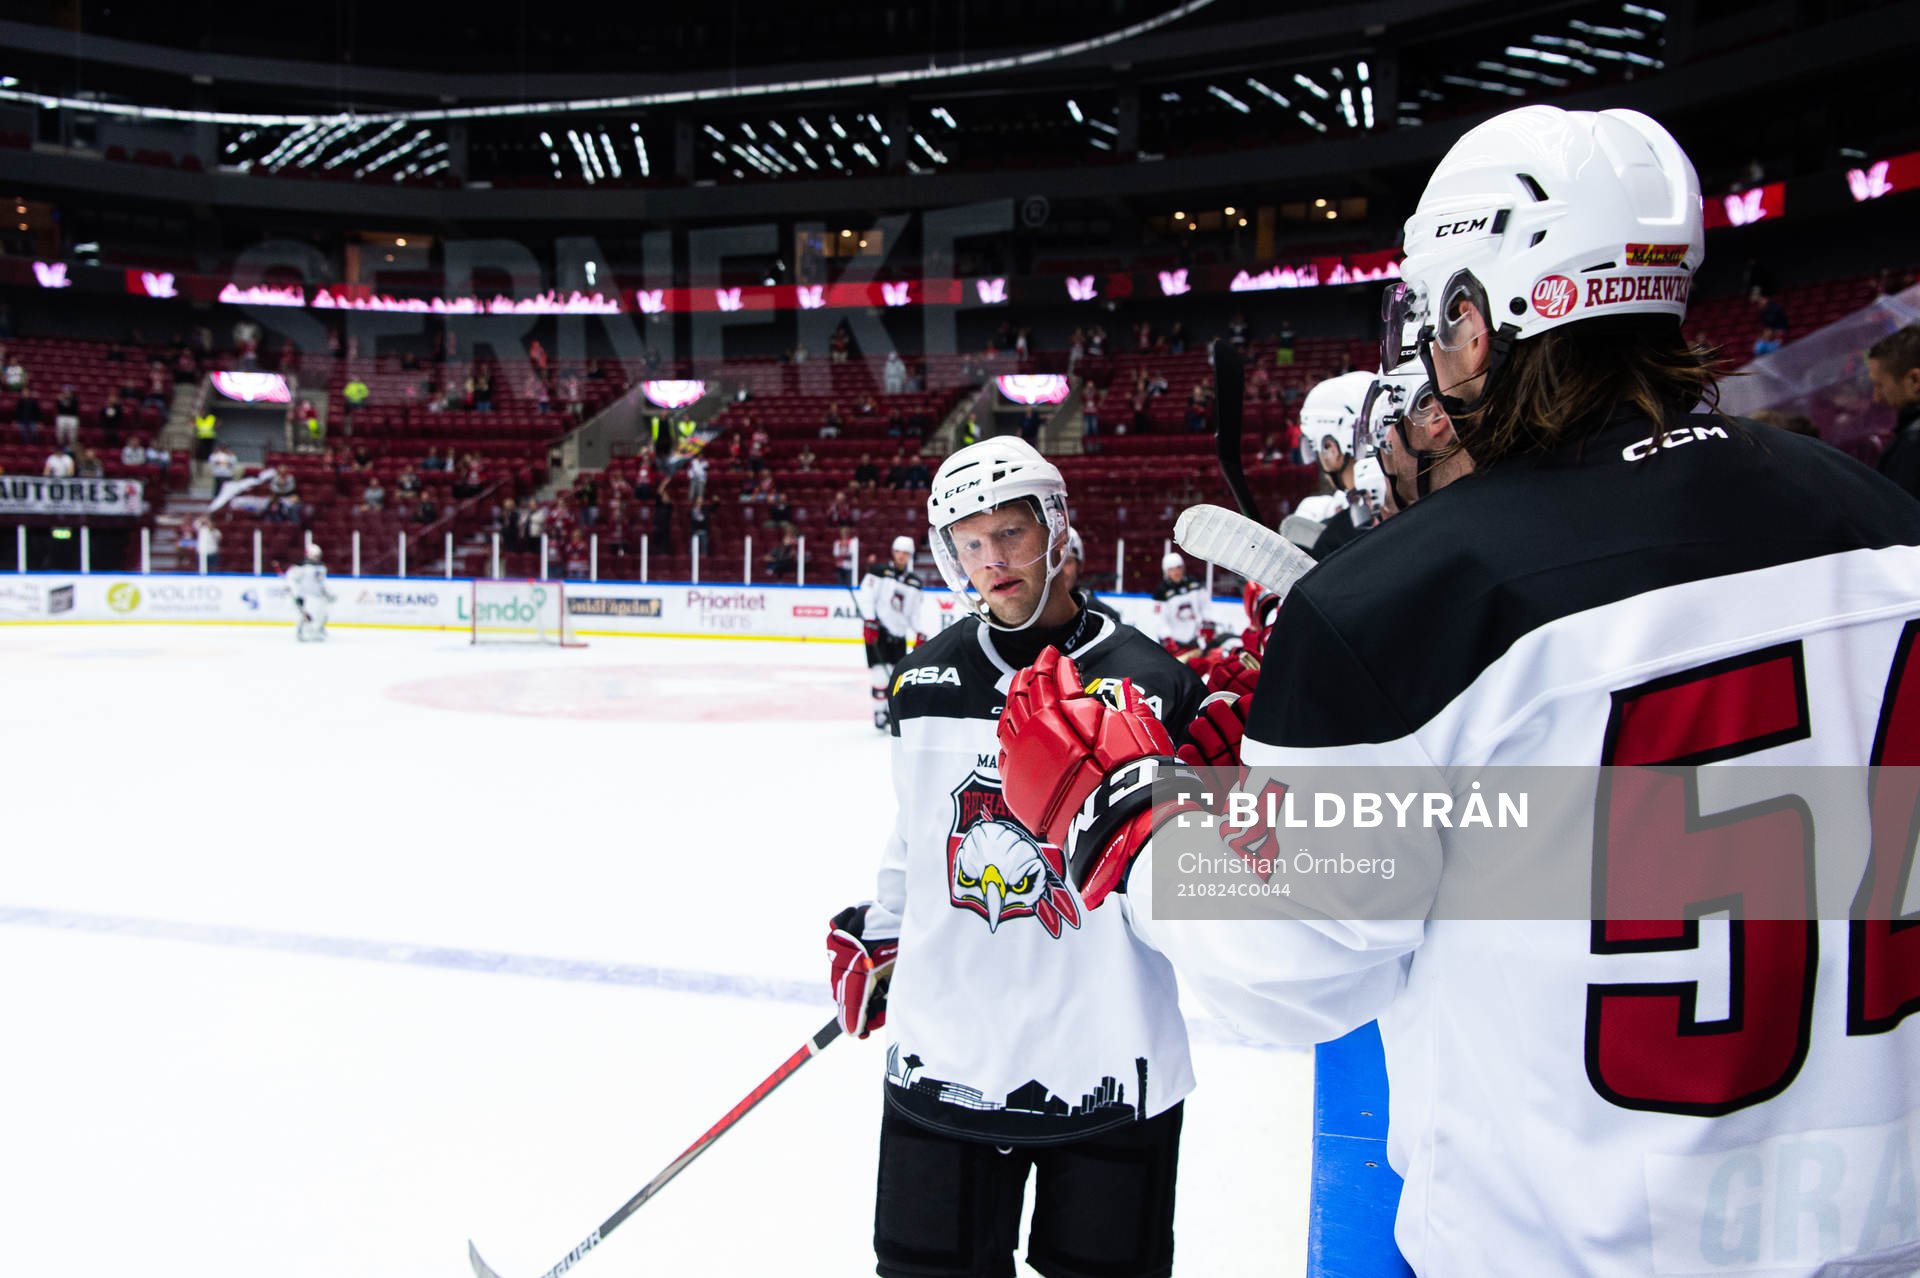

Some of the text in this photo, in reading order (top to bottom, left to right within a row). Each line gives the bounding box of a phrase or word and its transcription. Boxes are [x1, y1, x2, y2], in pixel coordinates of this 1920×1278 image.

[1435, 216, 1489, 238] CCM
[1621, 426, 1729, 462] CCM
[944, 478, 982, 500] CCM
[458, 595, 535, 622] Lendo
[687, 592, 766, 611] Prioritet
[899, 666, 962, 687] RSA
[977, 753, 998, 769] MA
[962, 790, 1012, 827] REDHA
